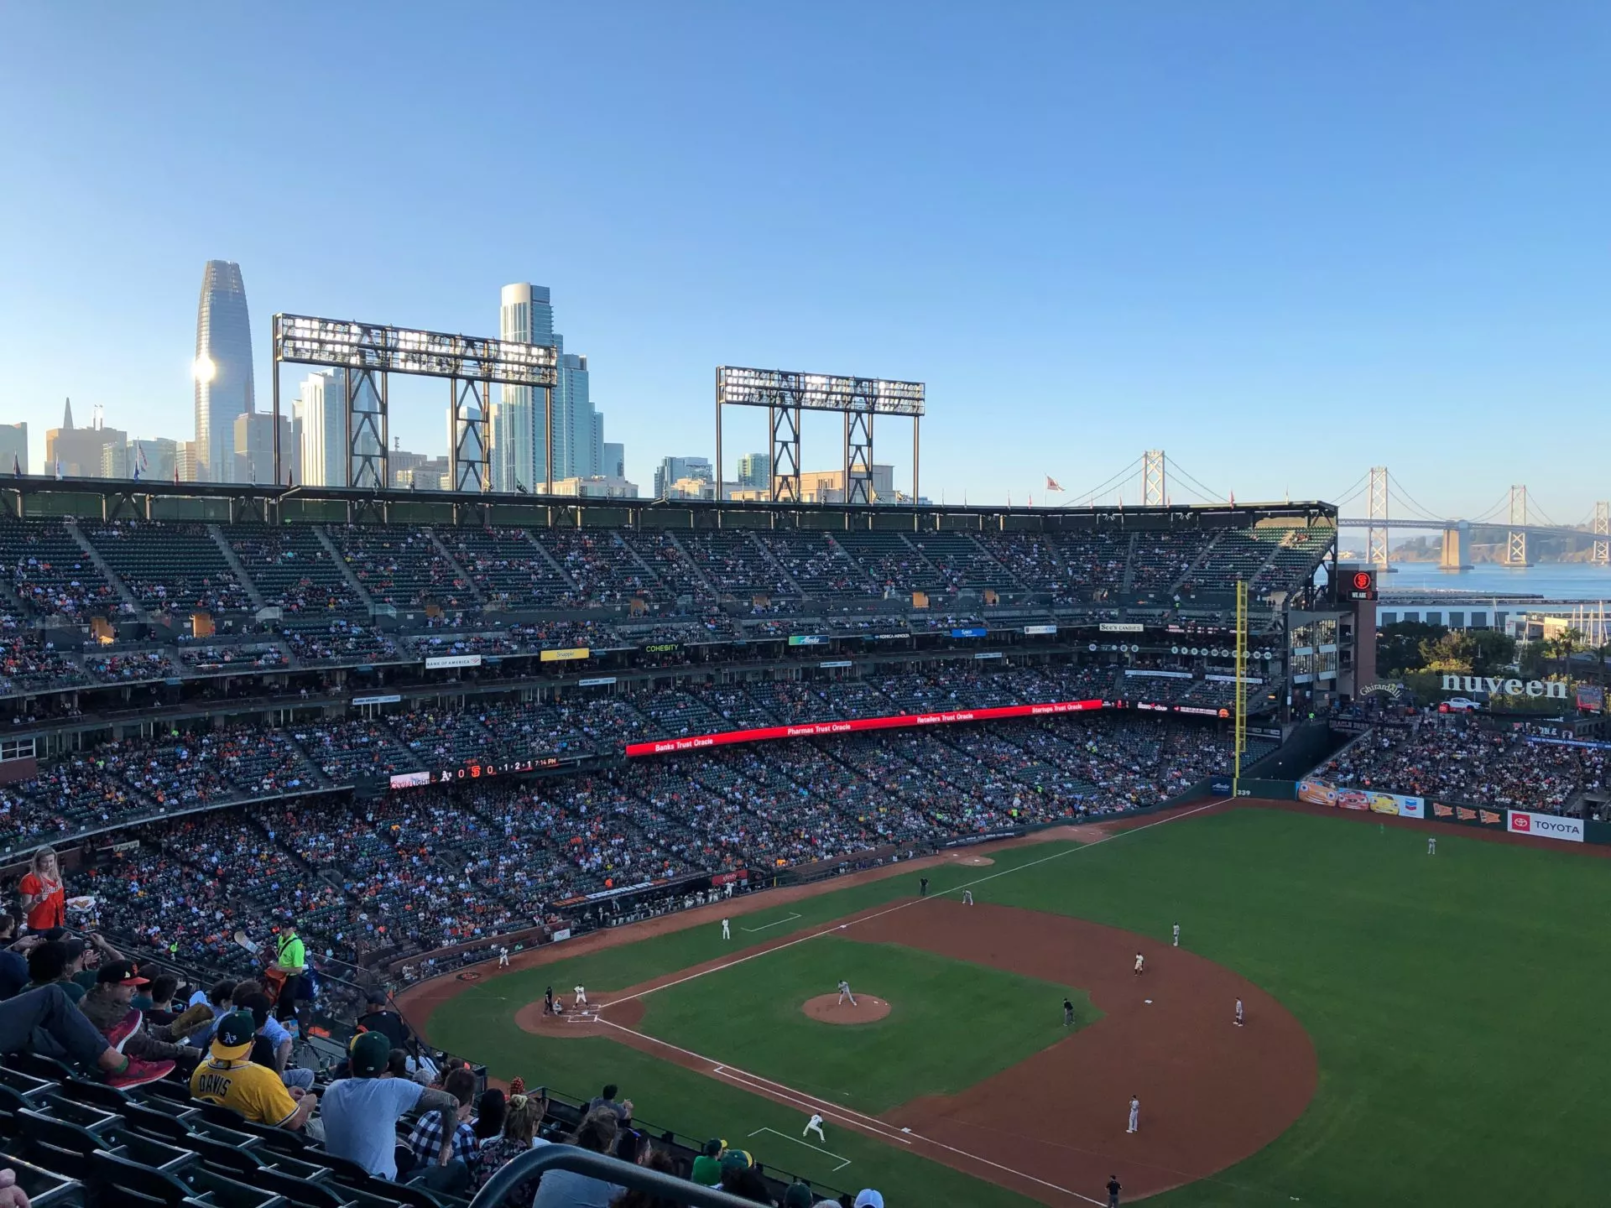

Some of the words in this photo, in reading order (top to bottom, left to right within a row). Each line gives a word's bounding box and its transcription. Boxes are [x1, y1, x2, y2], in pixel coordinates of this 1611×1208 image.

[1360, 683, 1403, 698] Ghirardelli
[1441, 674, 1568, 699] nuveen
[788, 727, 813, 735] Pharmas
[832, 723, 851, 731] Oracle
[655, 743, 674, 751] Banks
[677, 741, 692, 749] Trust
[694, 738, 713, 746] Oracle
[1534, 820, 1580, 834] TOYOTA
[199, 1074, 231, 1097] DAVIS
